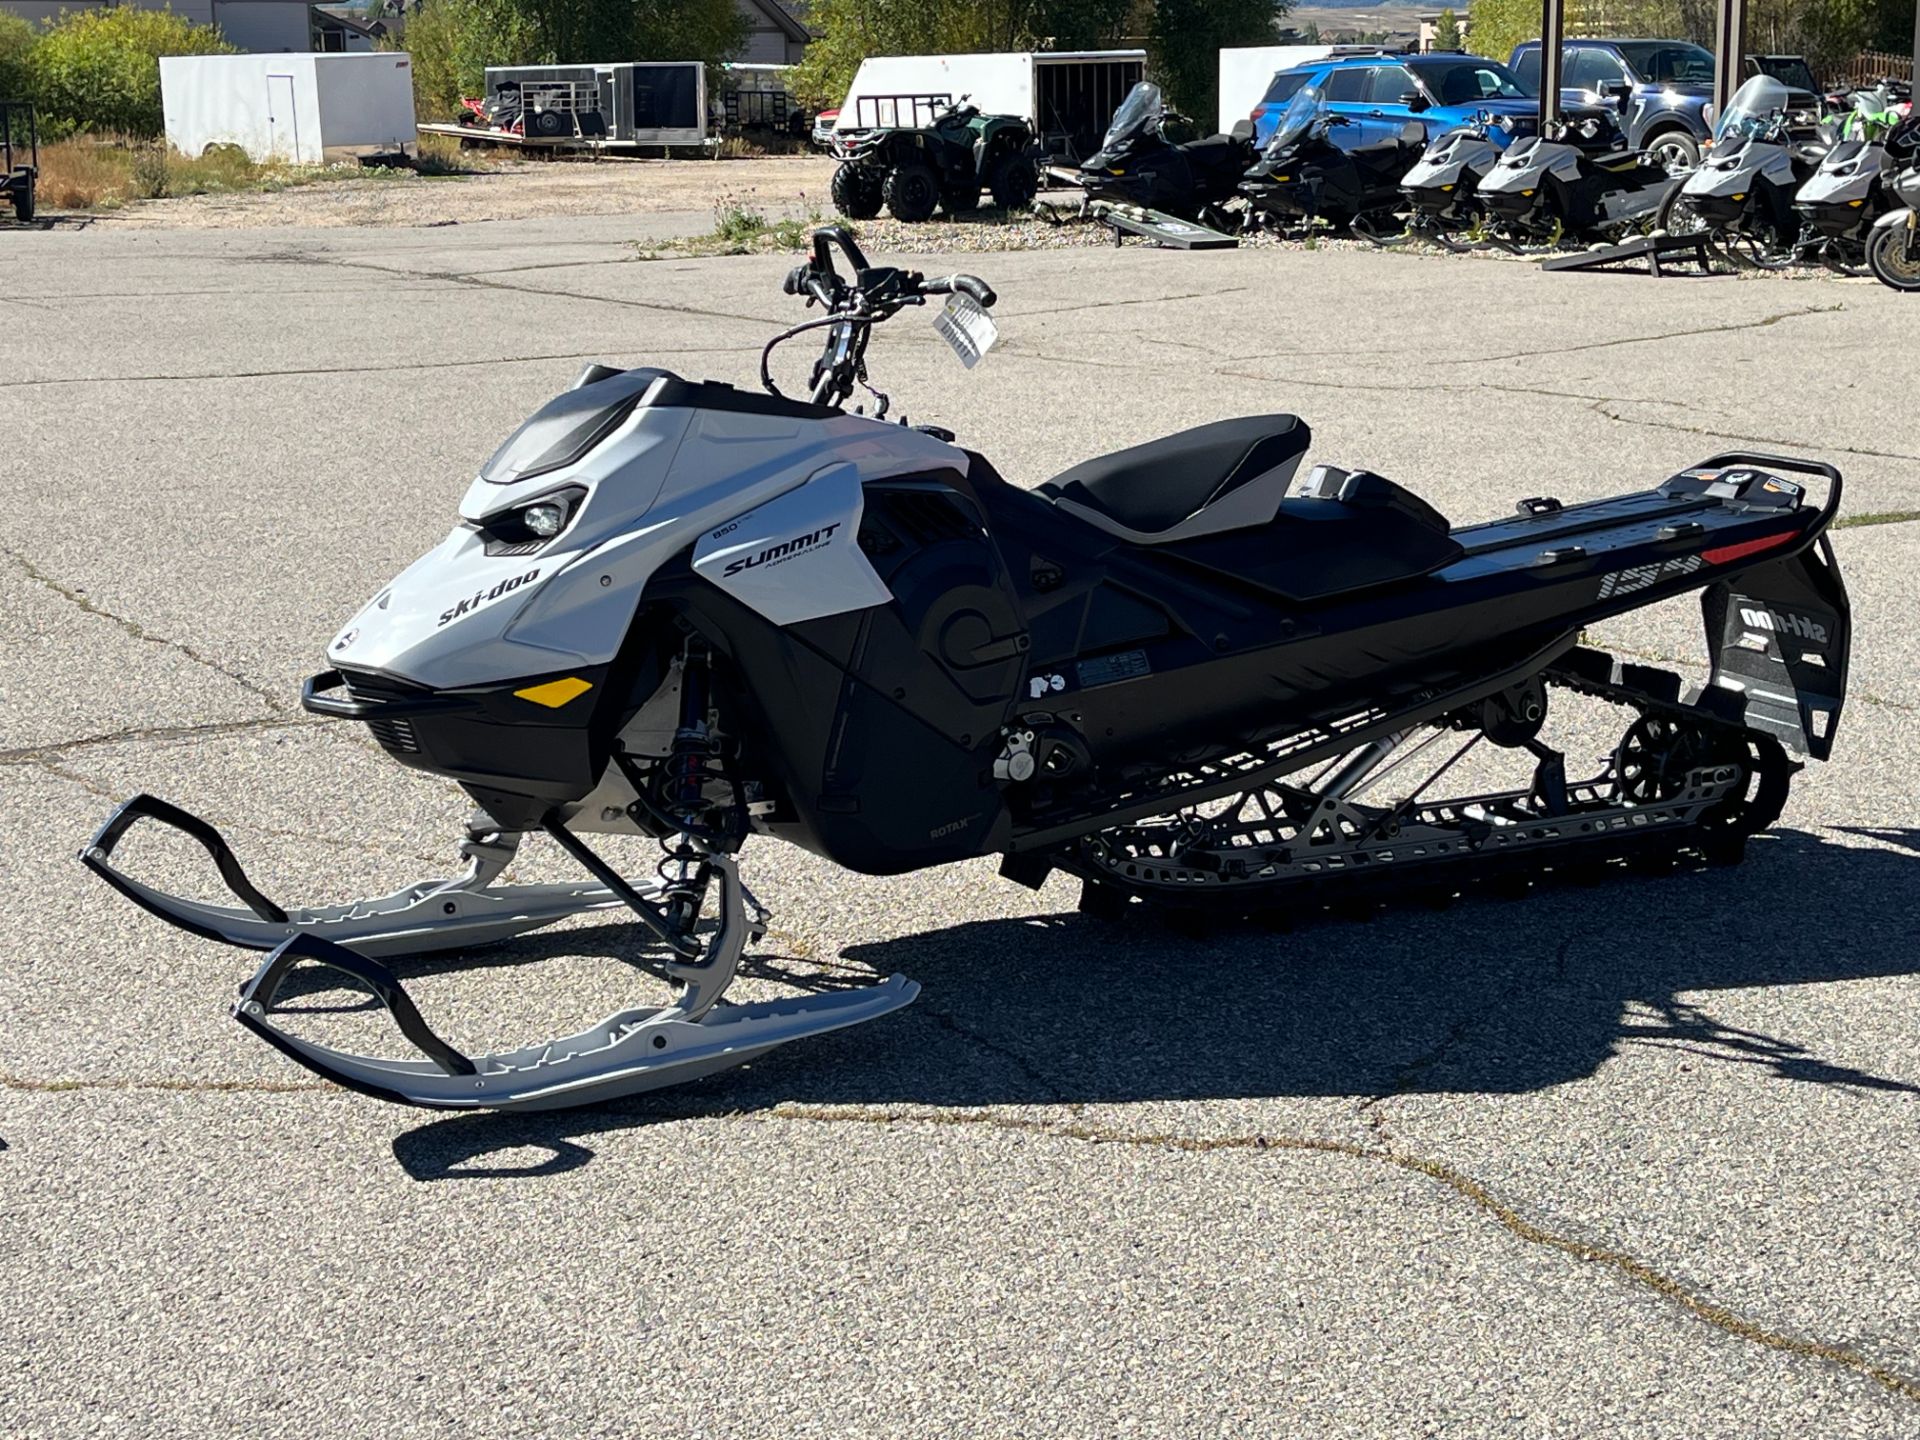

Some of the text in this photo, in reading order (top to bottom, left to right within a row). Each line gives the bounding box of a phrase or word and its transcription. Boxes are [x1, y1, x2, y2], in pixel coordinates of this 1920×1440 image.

[712, 523, 738, 540] 850
[722, 522, 841, 578] SUMMIT
[764, 540, 832, 569] ADRENALINE
[437, 568, 541, 627] ski-doo
[929, 816, 968, 840] ROTAX
